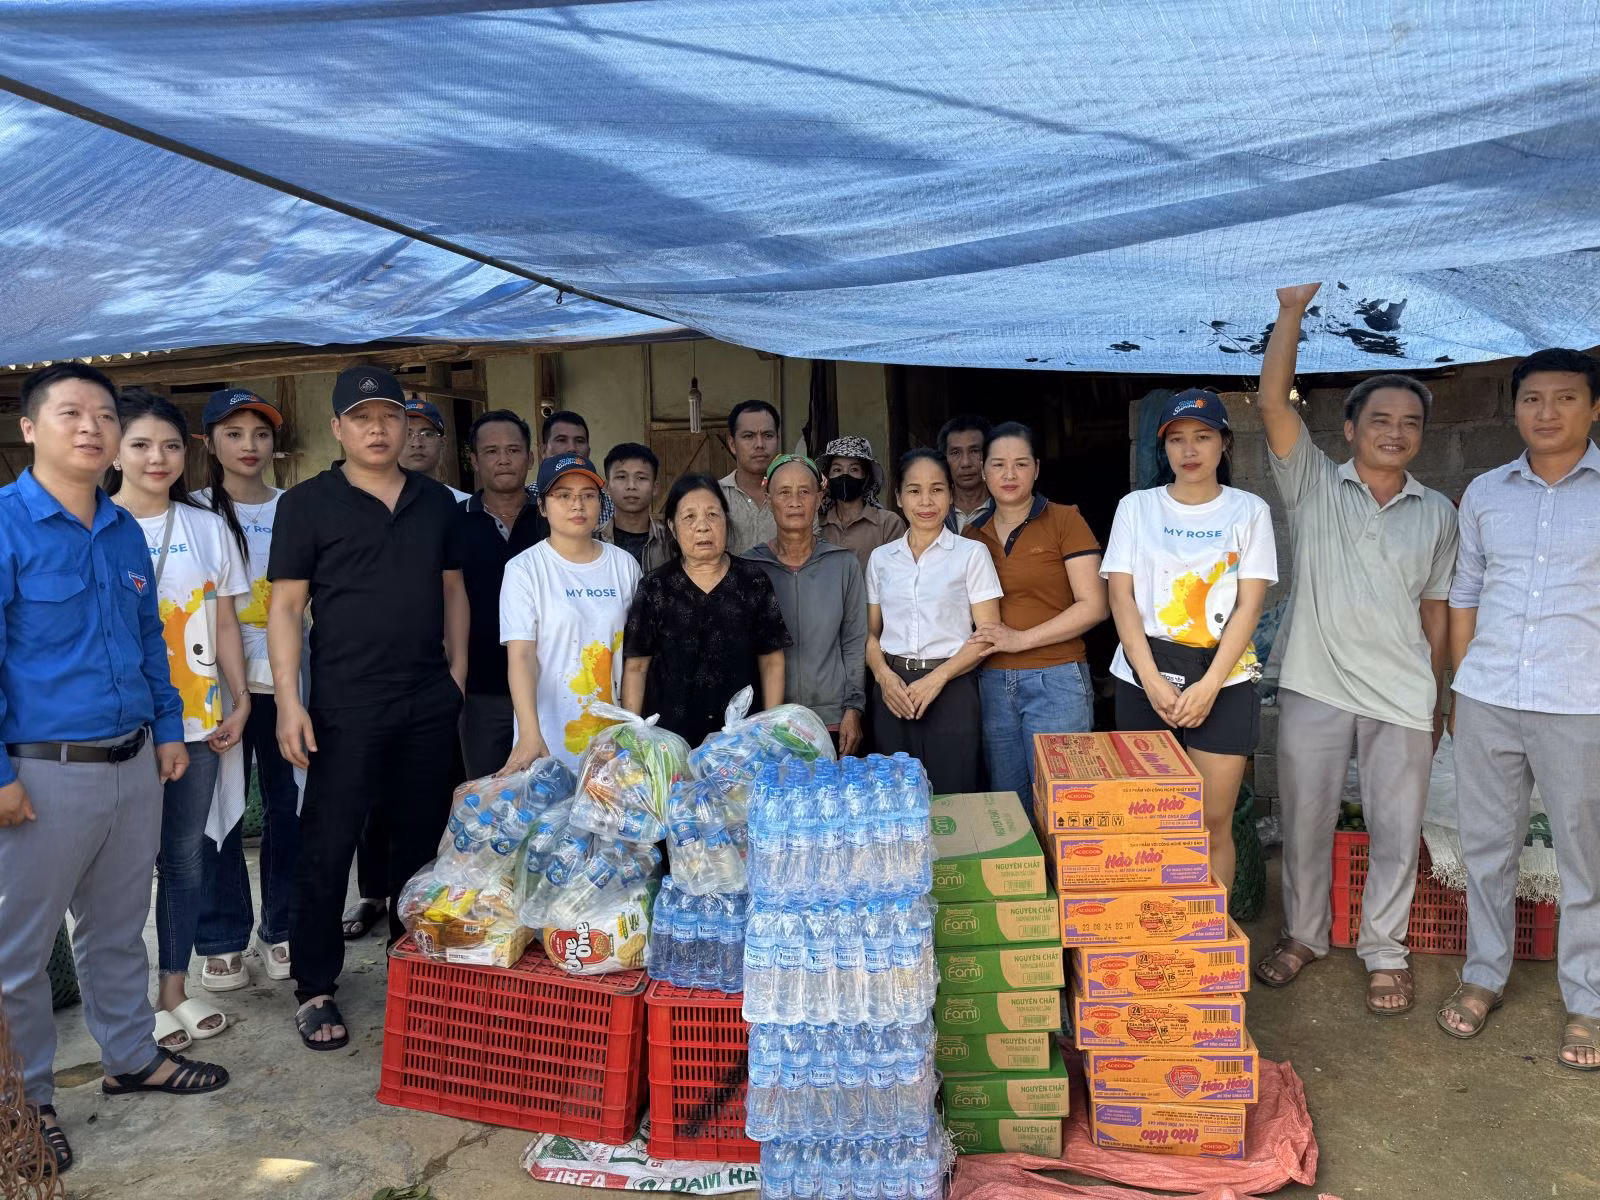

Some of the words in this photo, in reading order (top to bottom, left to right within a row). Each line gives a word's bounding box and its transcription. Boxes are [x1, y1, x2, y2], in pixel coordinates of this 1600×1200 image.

[255, 525, 272, 534] RO
[1164, 526, 1184, 537] MY
[1186, 530, 1223, 538] ROSE
[565, 588, 583, 597] MY
[586, 588, 617, 597] ROSE
[933, 875, 962, 885] ami
[944, 919, 977, 930] Fami
[948, 966, 980, 977] Fami
[945, 1007, 977, 1019] Fami
[955, 1094, 987, 1105] Fami
